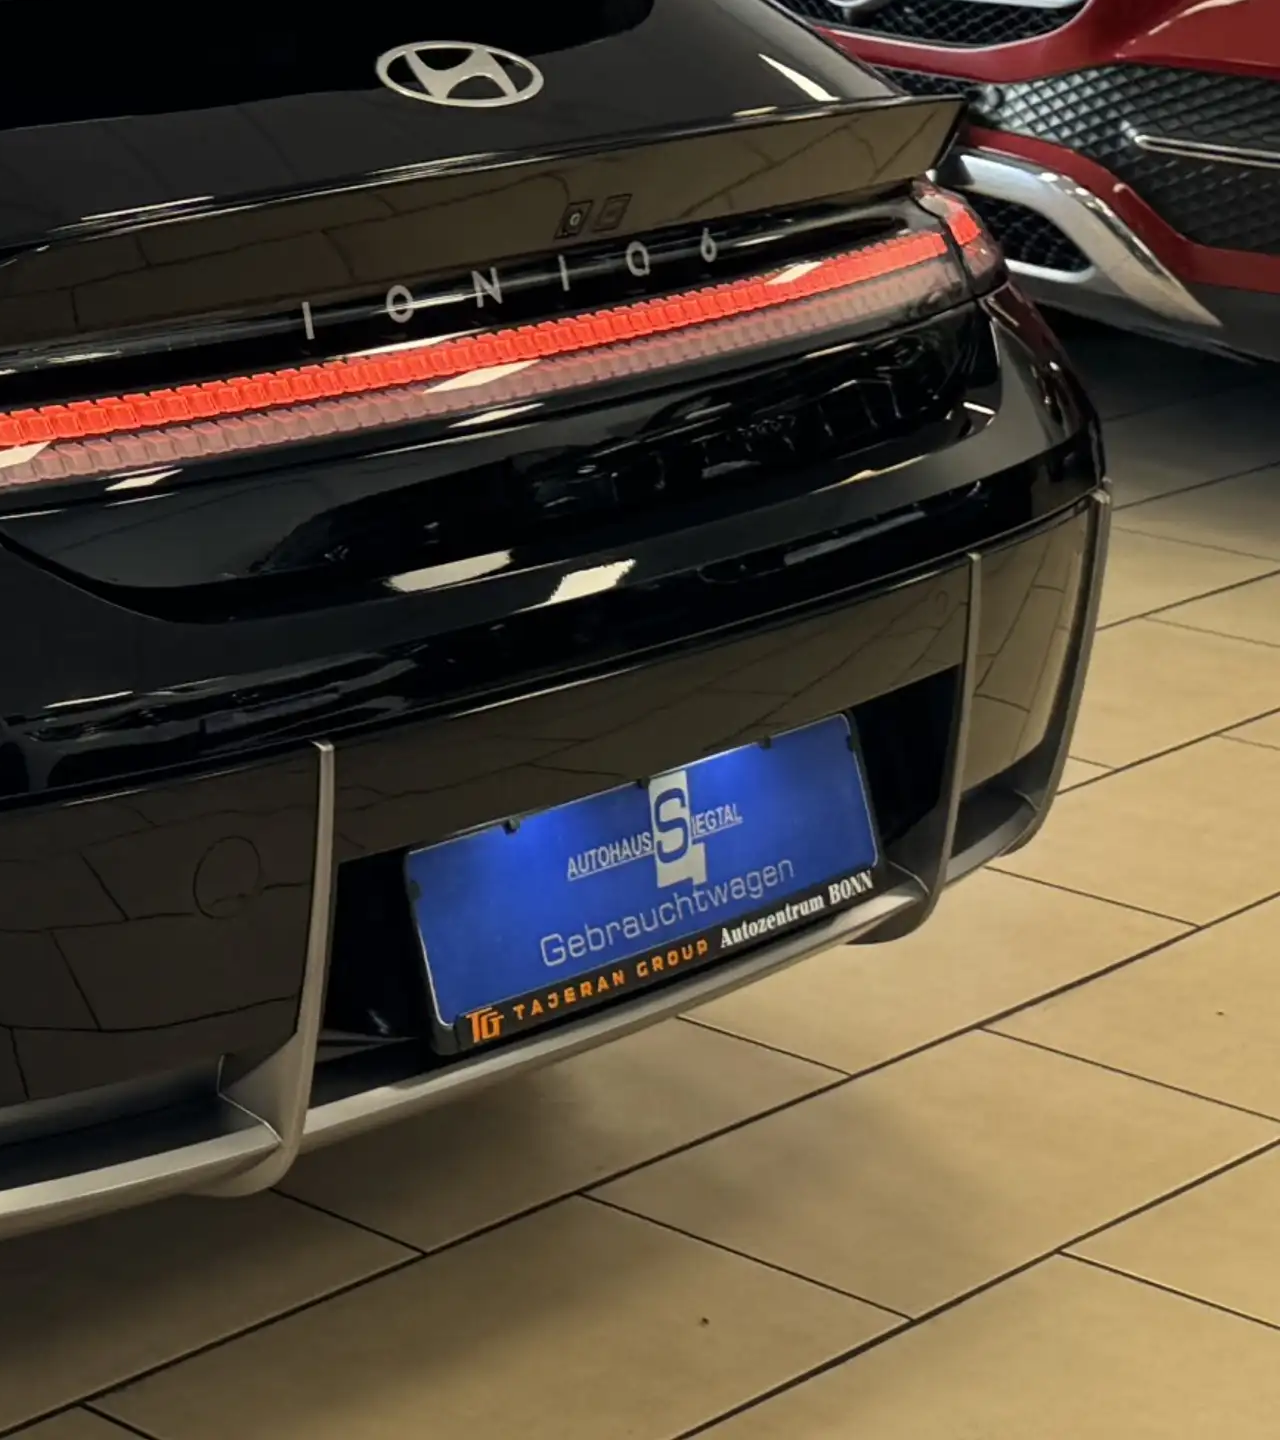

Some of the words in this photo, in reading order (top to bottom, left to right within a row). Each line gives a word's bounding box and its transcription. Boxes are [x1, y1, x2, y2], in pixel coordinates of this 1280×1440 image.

[303, 241, 650, 339] IONIQ
[700, 228, 717, 262] 6
[567, 830, 654, 881] AUTOHAUS
[513, 970, 625, 1020] TAJERAN
[636, 939, 709, 978] GROUP
[720, 894, 825, 949] Autozentrum
[828, 869, 874, 907] BONN
[540, 859, 795, 967] Gebrauchtwagen
